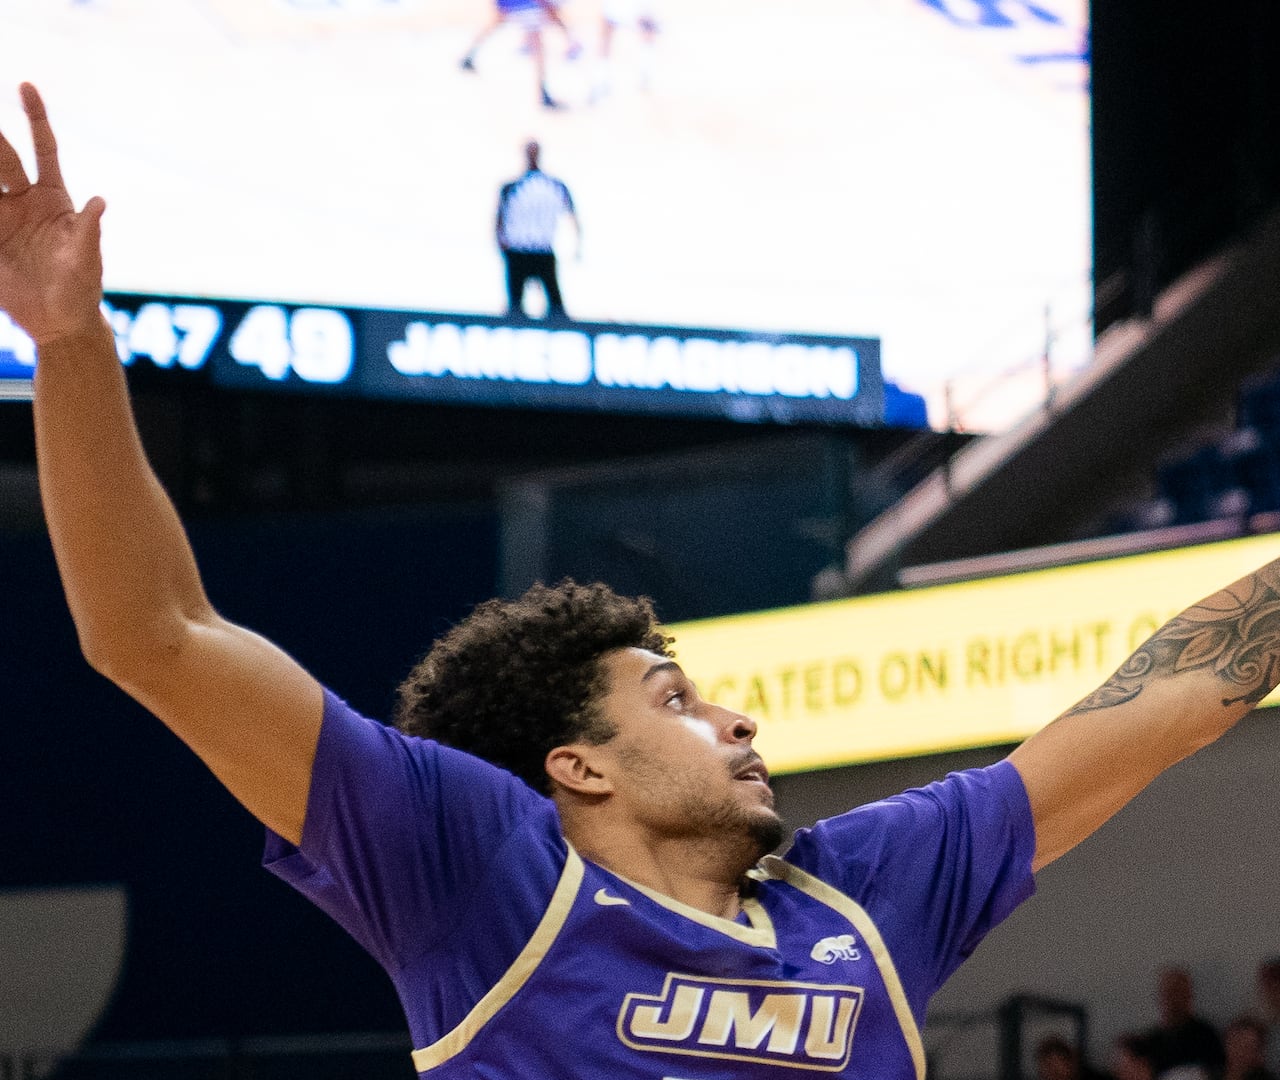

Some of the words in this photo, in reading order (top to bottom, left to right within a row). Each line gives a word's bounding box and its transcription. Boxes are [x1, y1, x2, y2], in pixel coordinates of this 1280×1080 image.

[388, 321, 594, 386] JAMES
[881, 650, 948, 702] ON
[965, 620, 1110, 687] RIGHT
[630, 985, 854, 1060] JMU
